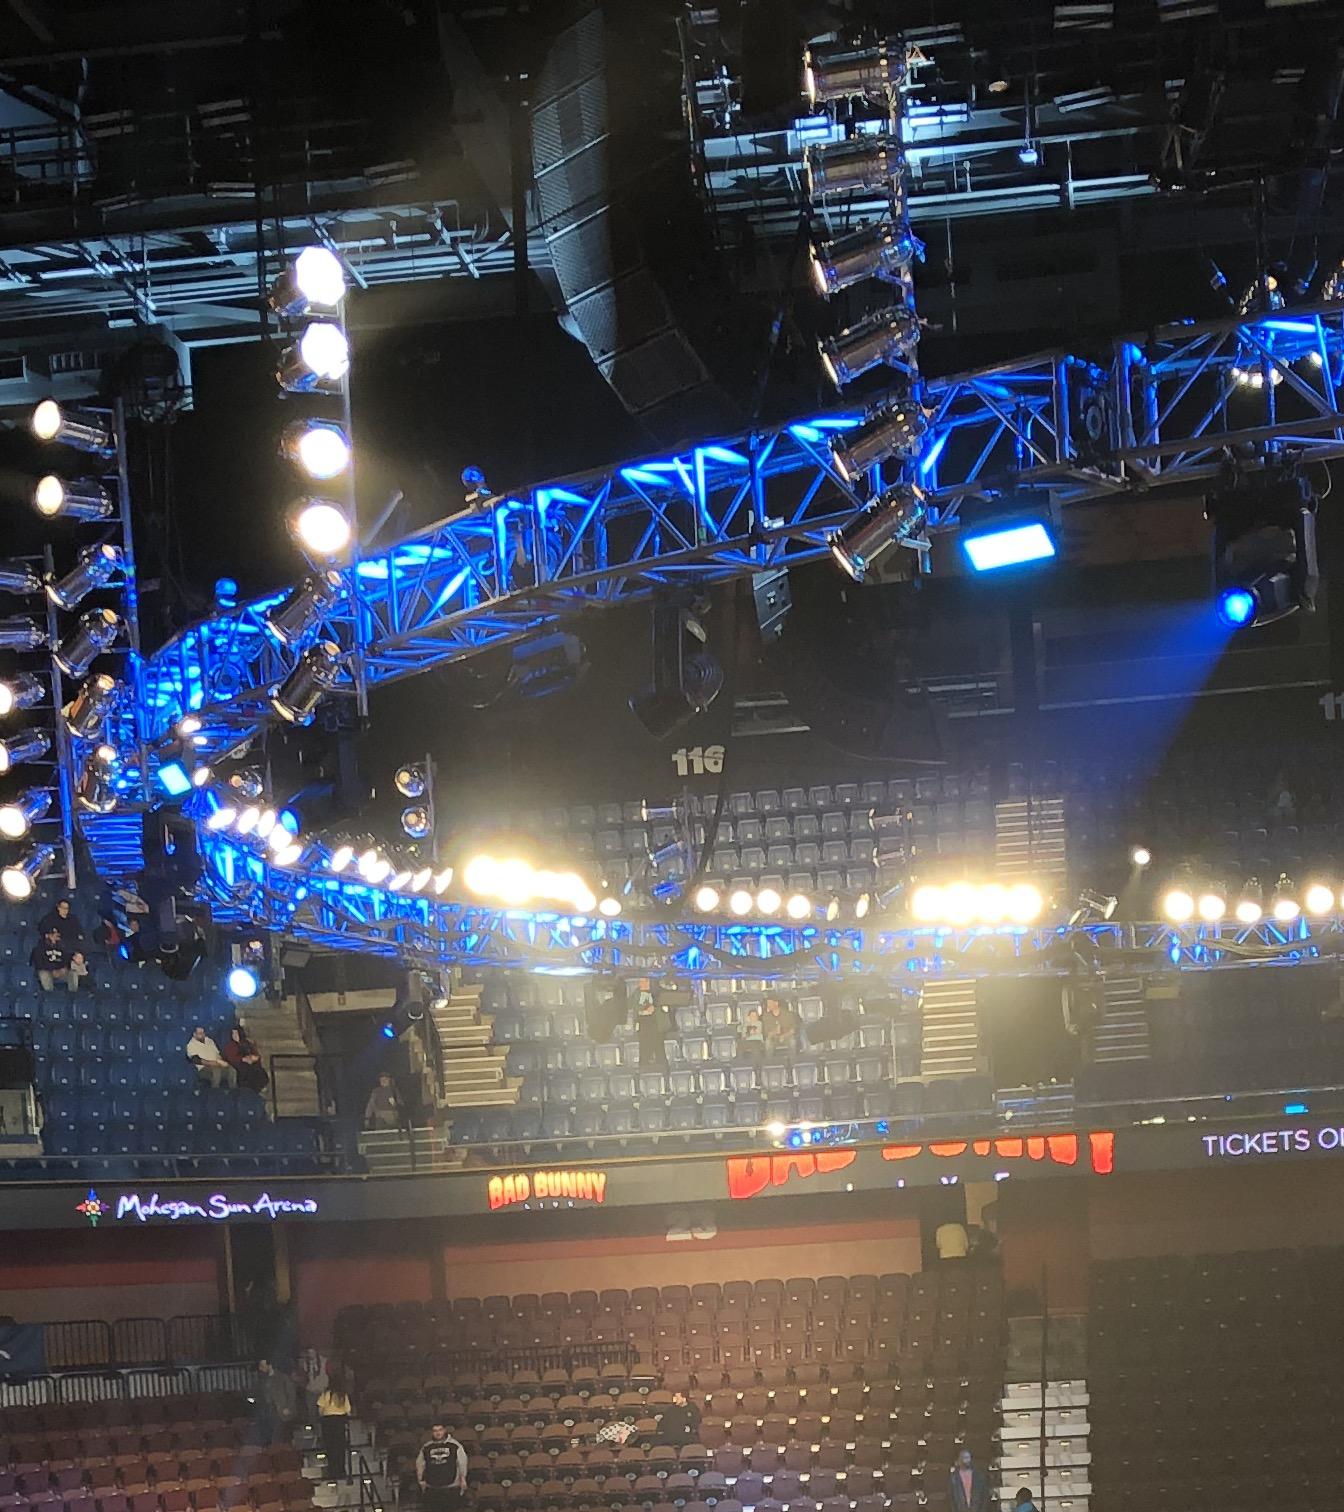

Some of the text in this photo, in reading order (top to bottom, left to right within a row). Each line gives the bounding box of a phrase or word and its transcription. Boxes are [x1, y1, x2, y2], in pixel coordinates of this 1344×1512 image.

[671, 744, 725, 776] 116
[1201, 1128, 1311, 1157] TICKETS
[488, 1170, 607, 1211] BAD BUNNY
[116, 1192, 318, 1222] Mohegan Sun Arena
